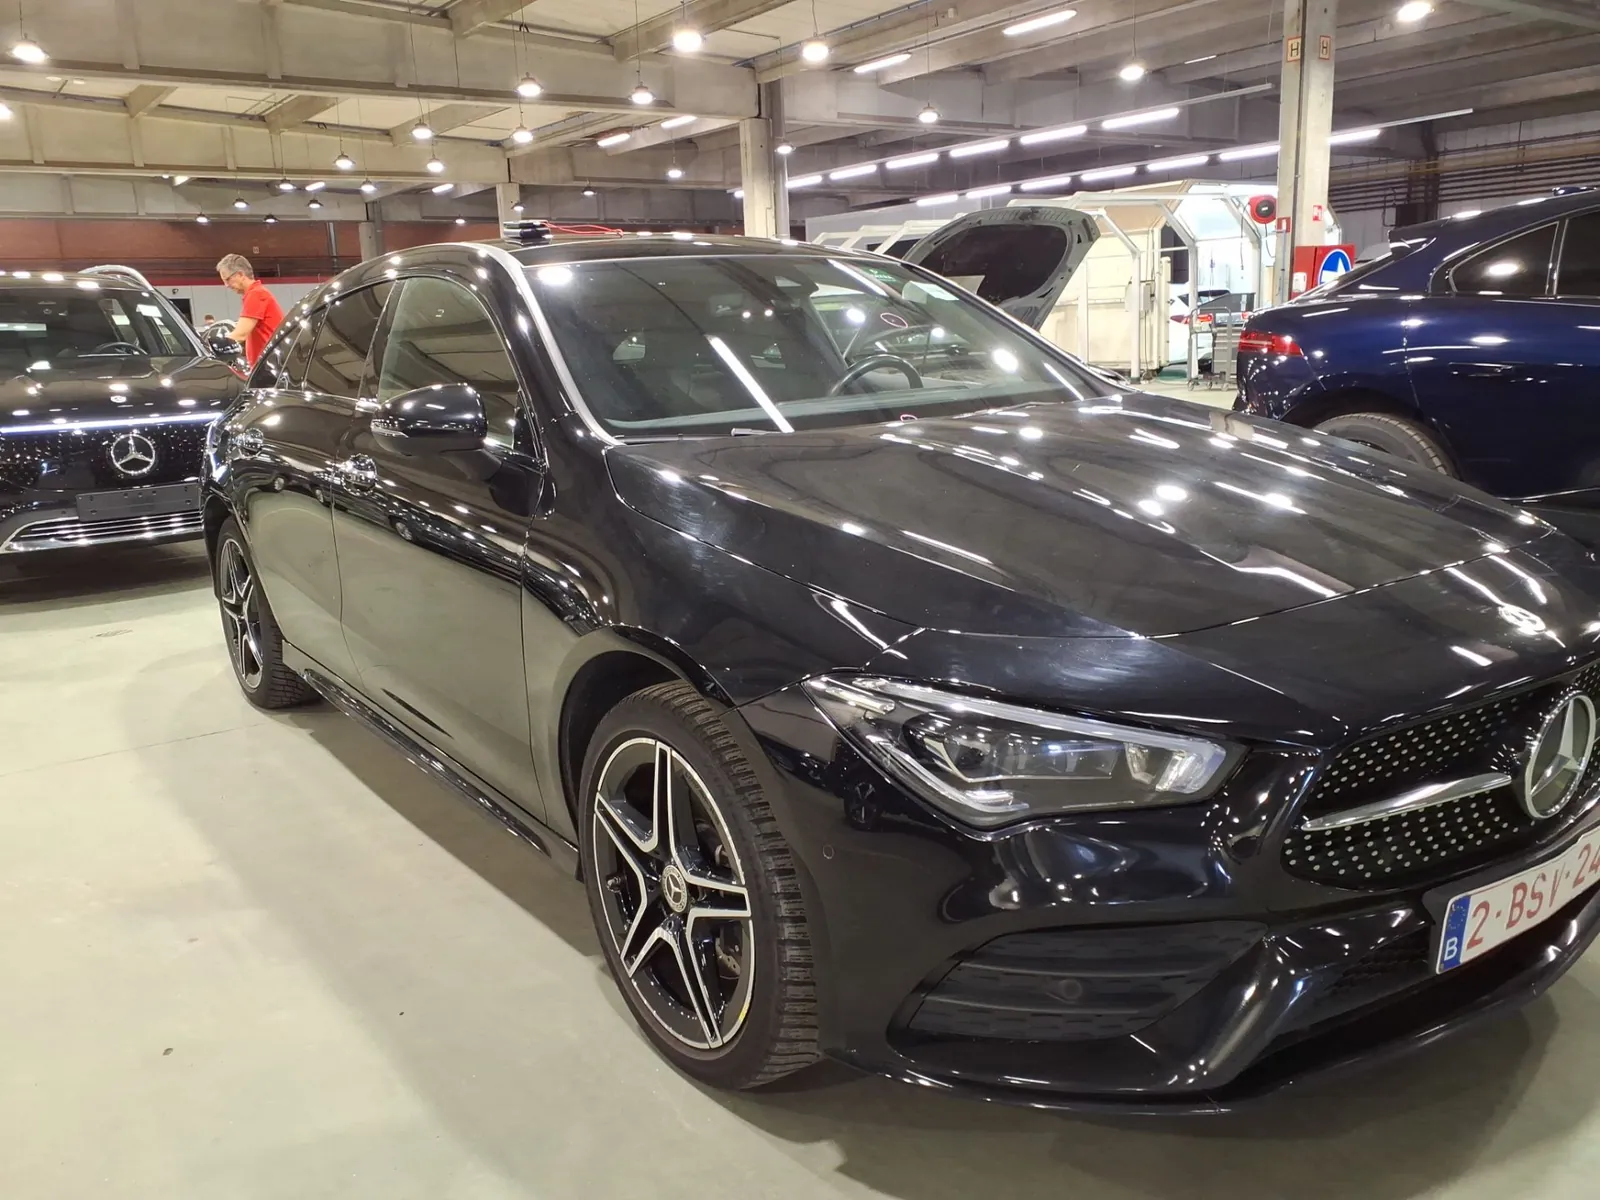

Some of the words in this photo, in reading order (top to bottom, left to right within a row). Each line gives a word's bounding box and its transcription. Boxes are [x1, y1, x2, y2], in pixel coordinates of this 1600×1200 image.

[1290, 41, 1300, 57] H
[1321, 40, 1328, 56] H
[1444, 937, 1458, 961] B
